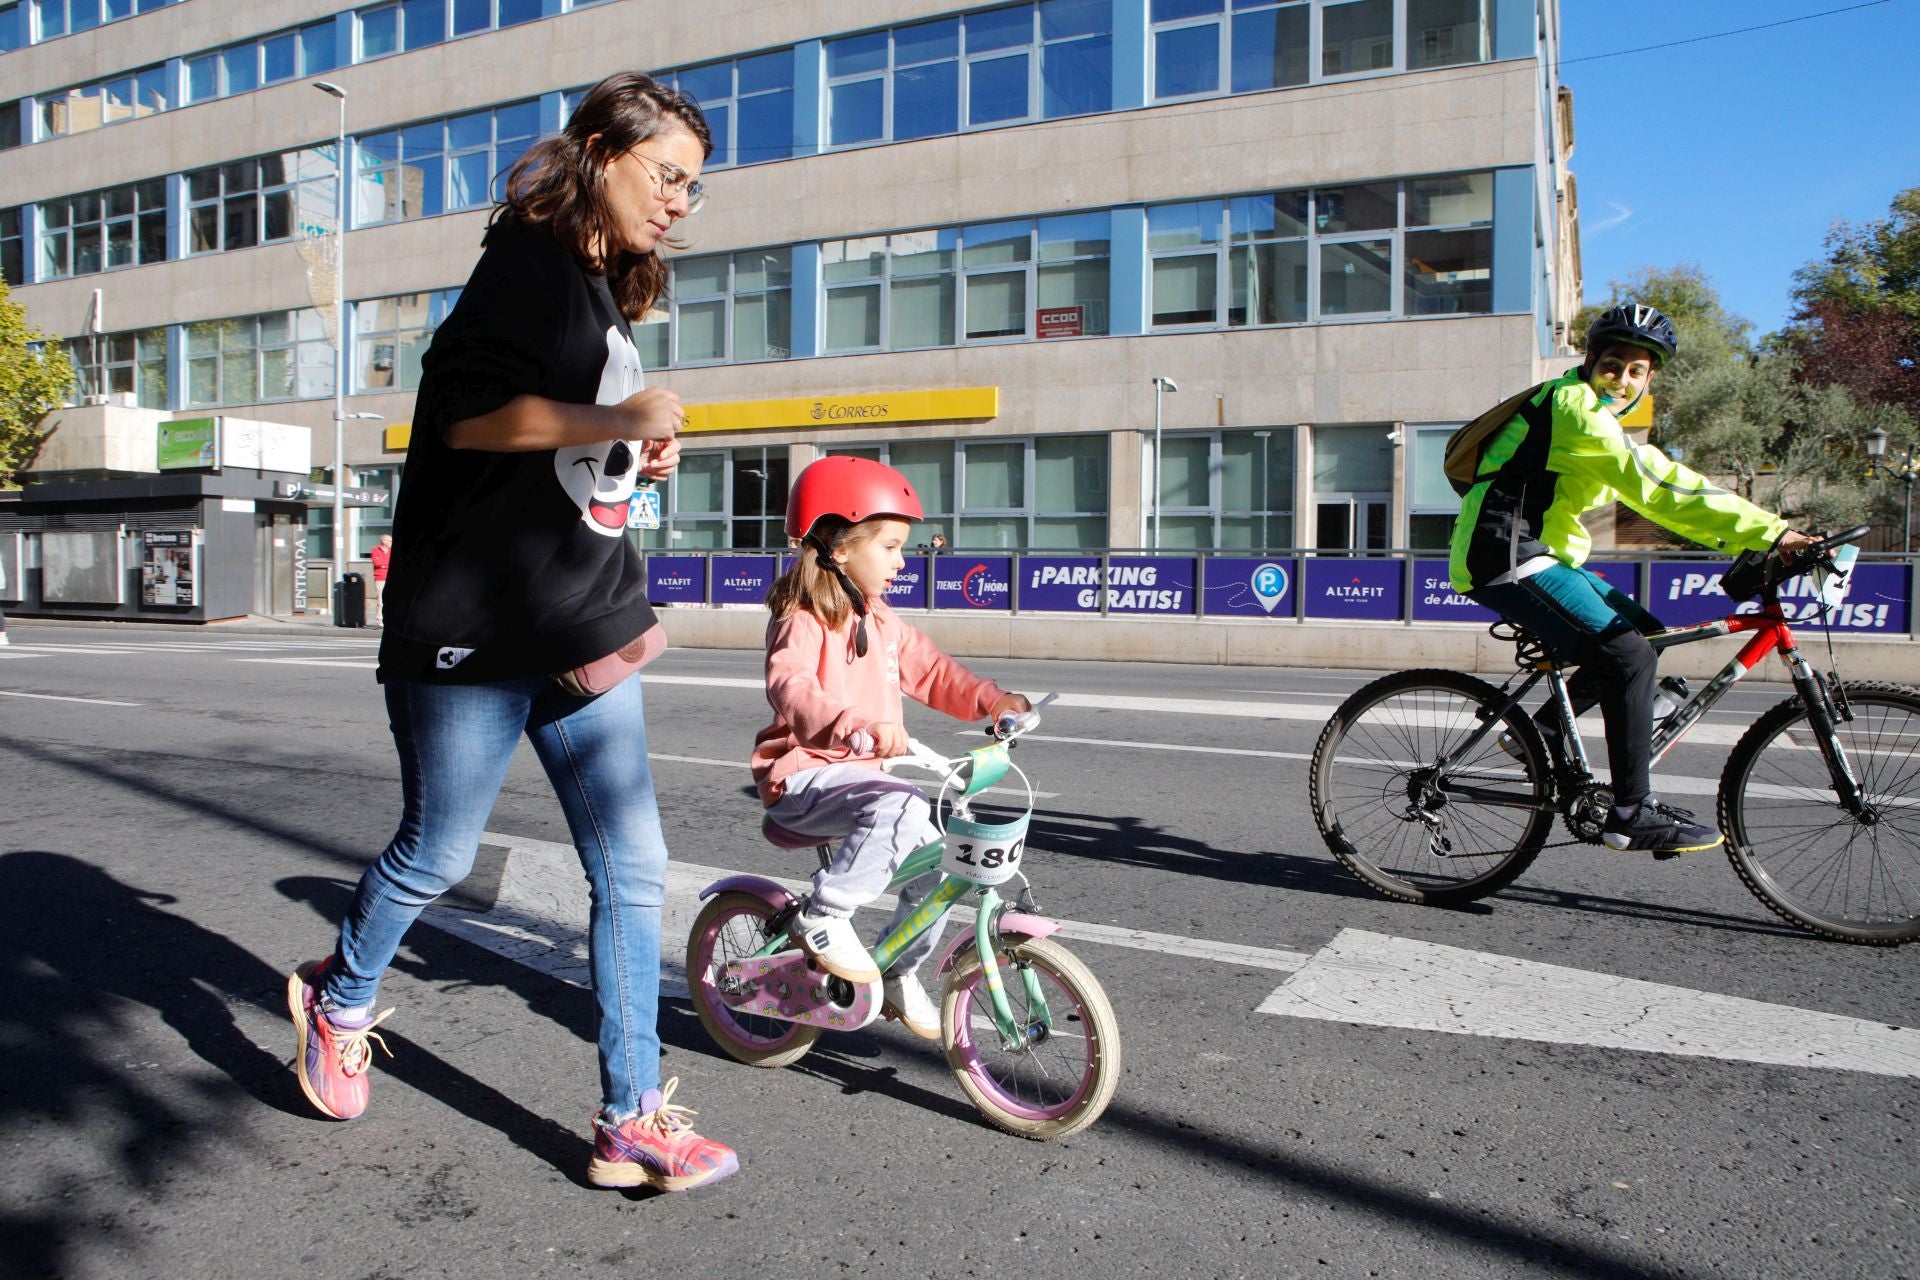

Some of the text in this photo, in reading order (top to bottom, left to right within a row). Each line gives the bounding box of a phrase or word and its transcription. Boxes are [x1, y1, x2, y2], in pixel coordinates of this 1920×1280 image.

[1041, 312, 1078, 324] CCOO
[828, 404, 889, 420] CORREOS
[294, 538, 307, 609] ENTRADA
[657, 578, 692, 586] ALTAFIT
[723, 578, 763, 587] ALTAFIT
[936, 577, 1008, 596] TIENES 1 HORA
[1424, 578, 1437, 589] Si
[1325, 586, 1384, 597] ALTAFIT
[1077, 589, 1183, 610] GRATIS!
[1424, 593, 1480, 606] de ALTA
